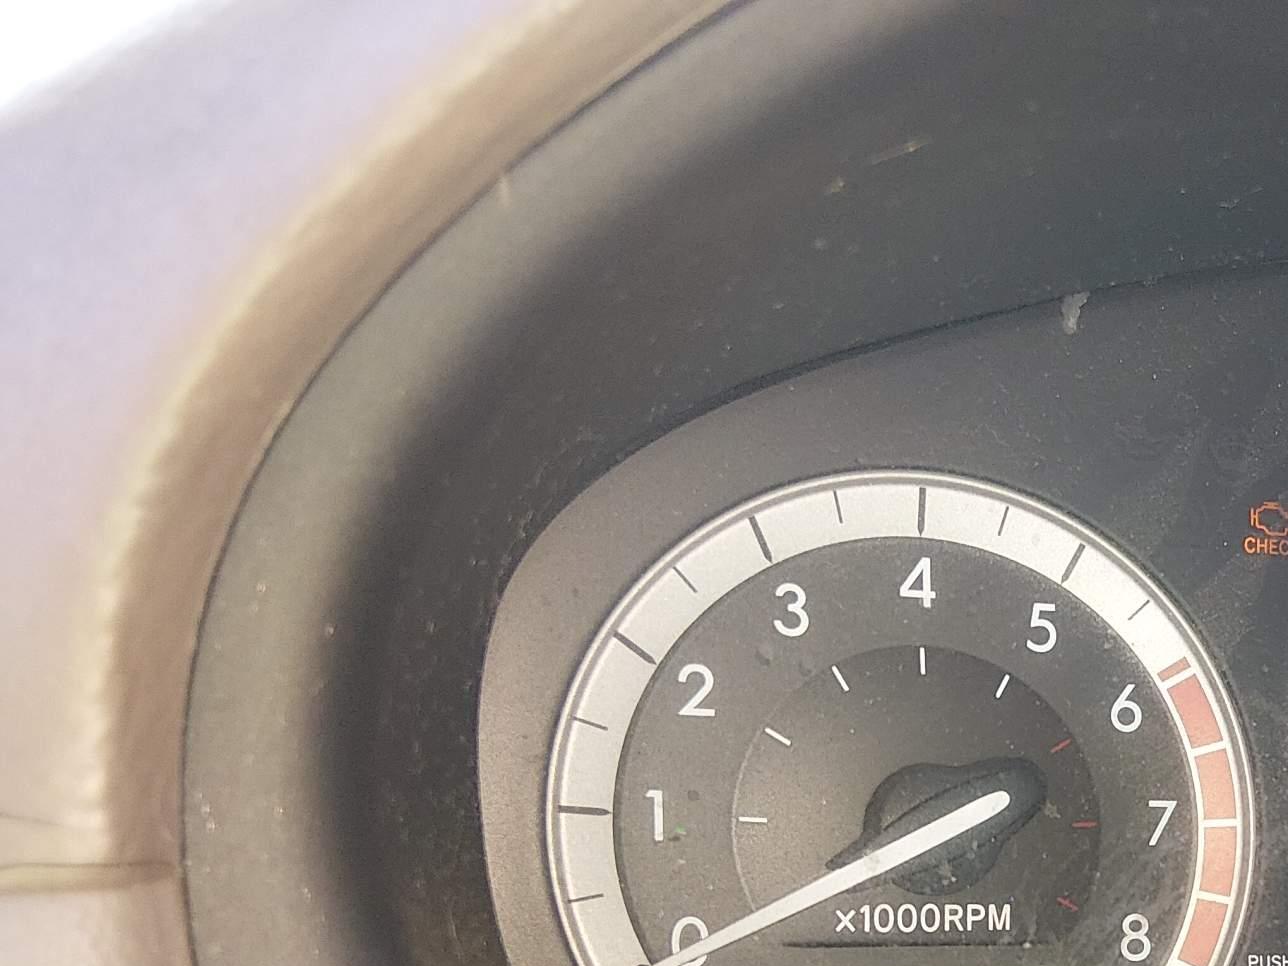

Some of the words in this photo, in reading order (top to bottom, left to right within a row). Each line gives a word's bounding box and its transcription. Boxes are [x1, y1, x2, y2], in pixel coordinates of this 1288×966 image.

[900, 557, 936, 608] 4
[774, 583, 809, 636] 3
[1026, 603, 1057, 652] 5
[677, 664, 715, 716] 2
[1110, 684, 1144, 733] 6
[646, 790, 665, 842] 1
[1148, 800, 1177, 846] 7
[1121, 913, 1151, 962] 8
